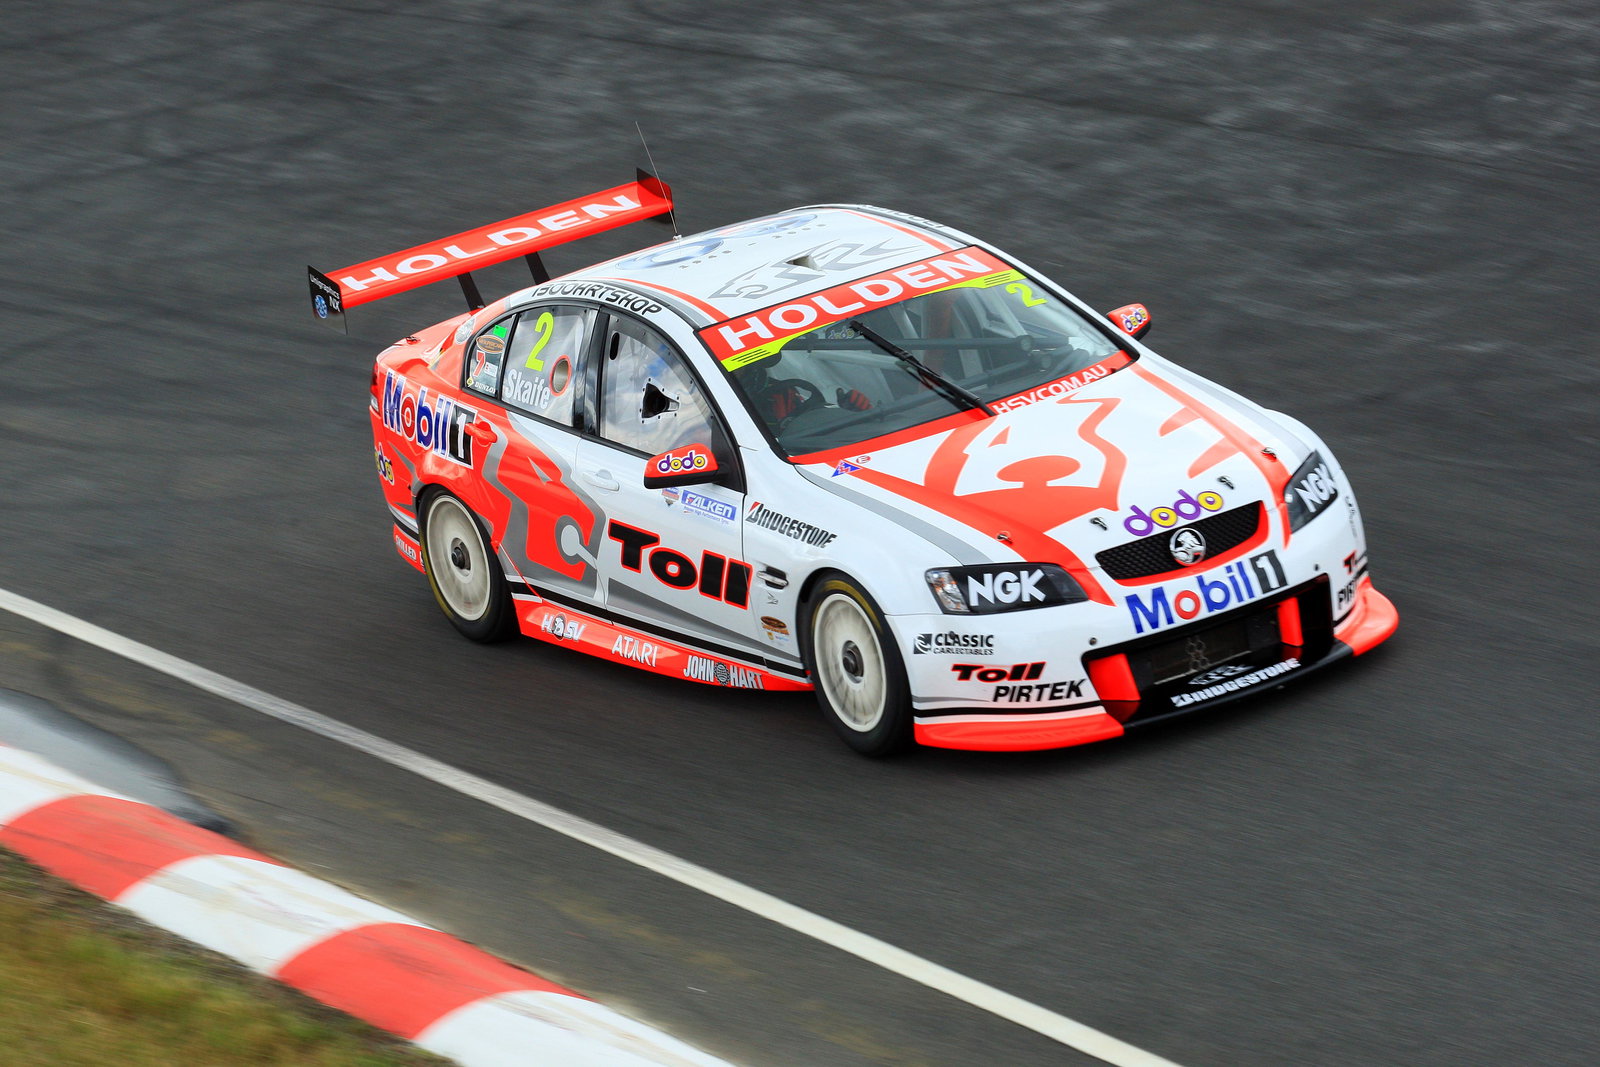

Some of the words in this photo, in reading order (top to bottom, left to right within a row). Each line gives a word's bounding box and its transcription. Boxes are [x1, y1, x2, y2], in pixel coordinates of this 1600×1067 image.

[341, 195, 642, 291] HOLDEN
[717, 252, 992, 351] HOLDEN
[1006, 283, 1046, 307] 2
[1120, 307, 1147, 332] dodo
[525, 312, 553, 372] 2
[505, 369, 550, 409] Skaife
[383, 369, 452, 459] Mobil
[657, 451, 707, 473] dodo
[684, 493, 734, 520] FALKEN
[1294, 463, 1338, 513] NGK
[746, 501, 837, 549] BRIDGESTONE
[1124, 489, 1224, 537] dodo
[608, 518, 754, 610] Toll
[967, 569, 1046, 607] NGK
[1125, 561, 1255, 634] Mobil
[1254, 553, 1284, 591] 1
[611, 634, 659, 668] ATARI
[934, 633, 994, 648] CLASSIC
[683, 655, 715, 682] JOHN
[730, 665, 765, 690] HART
[951, 661, 1047, 684] Toll
[992, 679, 1087, 703] PIRTEK
